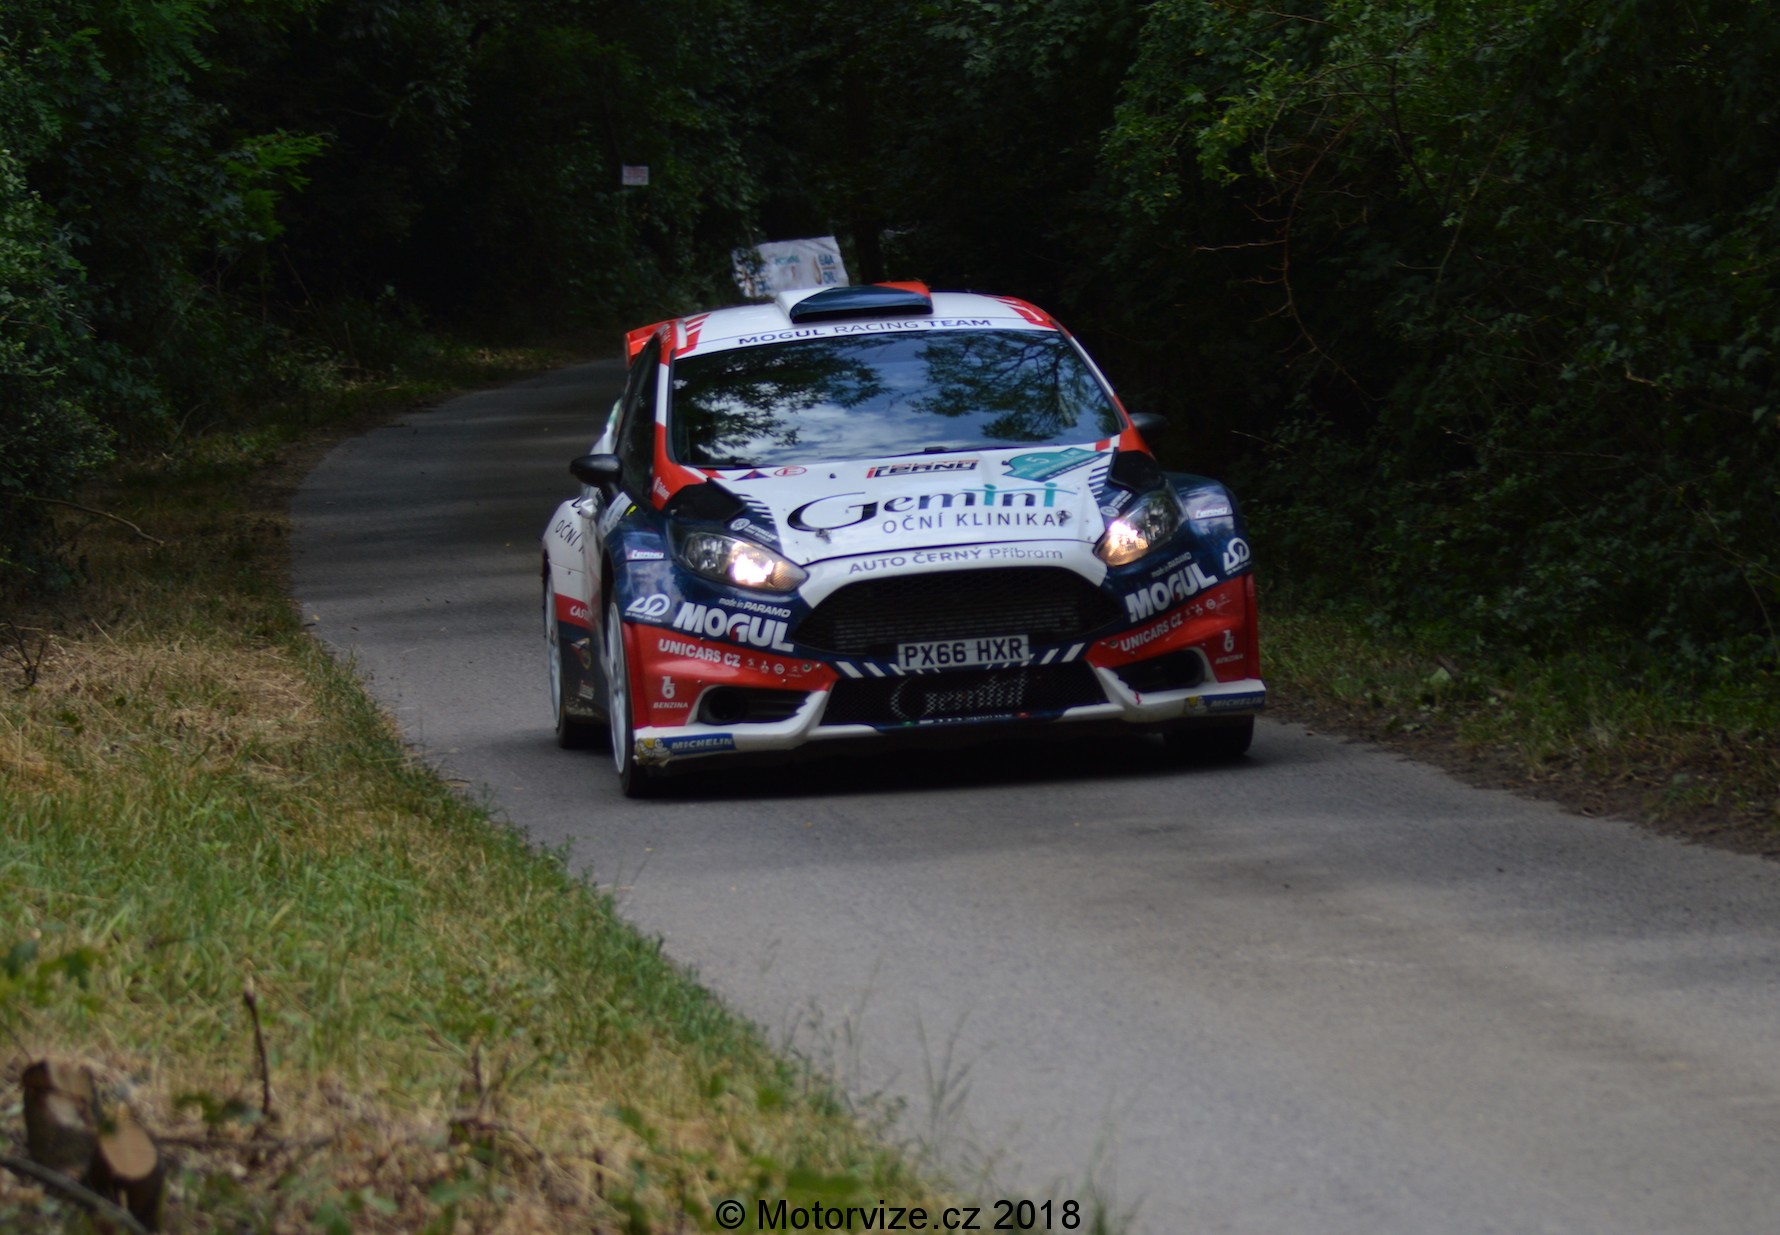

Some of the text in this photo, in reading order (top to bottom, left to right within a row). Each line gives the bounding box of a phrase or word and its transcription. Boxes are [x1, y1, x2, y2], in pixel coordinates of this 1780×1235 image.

[738, 319, 992, 345] MOGUL RACING TEAM
[787, 482, 1056, 533] Gemini
[882, 512, 1056, 534] OČNÍ KLINIKA
[848, 546, 1063, 574] AUTO ČERNÝ Příbram
[1124, 562, 1218, 624] MOGUL
[743, 601, 792, 618] PARAMO
[672, 601, 795, 653] MOGUL
[1120, 612, 1184, 652] UNICARS CZ
[658, 638, 742, 668] UNICARS CZ
[903, 637, 1024, 667] PX66 HXR
[653, 701, 689, 709] BENZINA
[1210, 696, 1263, 707] MICHELIN
[671, 737, 734, 750] MICHELIN
